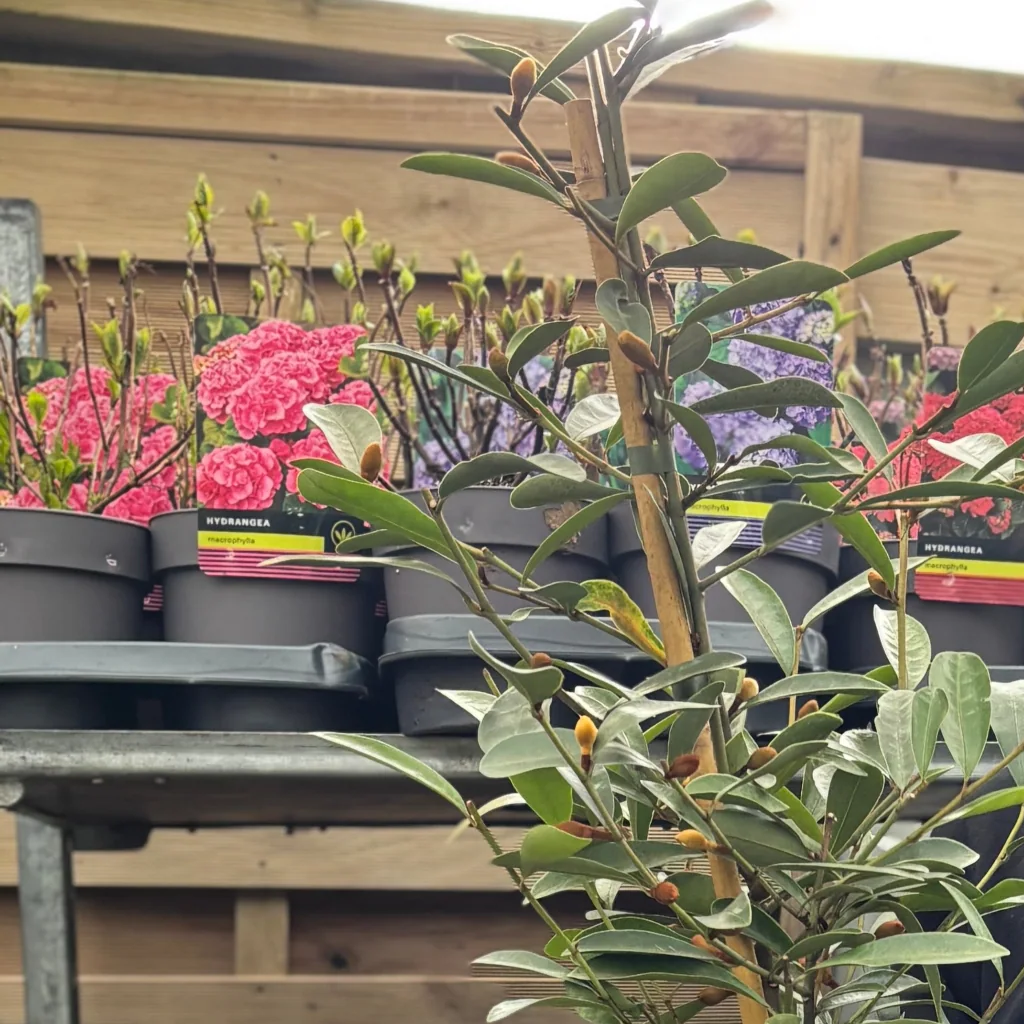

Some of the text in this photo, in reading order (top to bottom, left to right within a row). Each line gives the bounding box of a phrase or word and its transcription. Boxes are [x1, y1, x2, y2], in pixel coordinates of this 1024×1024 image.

[206, 516, 271, 528] HYDRANGEA
[207, 536, 256, 546] macrophylla
[924, 543, 983, 555] HYDRANGEA
